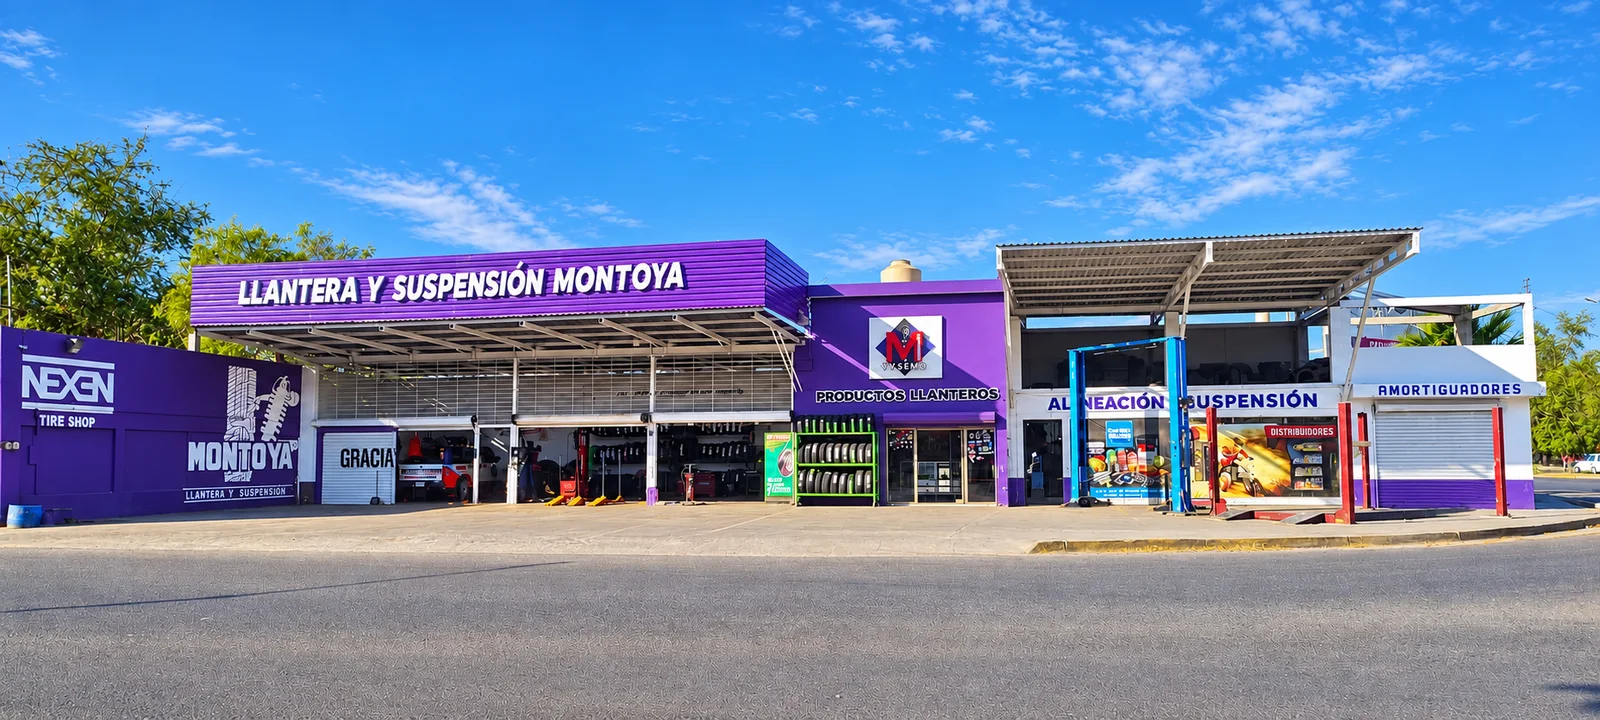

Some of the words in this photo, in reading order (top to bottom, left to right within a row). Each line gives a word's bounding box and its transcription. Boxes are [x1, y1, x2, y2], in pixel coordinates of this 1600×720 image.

[238, 276, 359, 306] LLANTERA
[368, 275, 386, 303] Y
[392, 260, 546, 303] SUSPENSIÓN
[552, 261, 686, 294] MONTOYA
[21, 365, 114, 403] NEXEN
[1378, 383, 1522, 396] AMORTIGUADORES
[815, 389, 906, 403] PRODUCTOS
[909, 387, 1001, 402] LLANTEROS
[1048, 392, 1165, 411] ALNEACIÓN
[39, 414, 65, 427] TIRE
[67, 415, 96, 429] SHOP
[1270, 427, 1334, 436] DISTRIBUIDORES
[187, 441, 294, 472] MONTOYA
[185, 490, 226, 500] LLANTERA
[228, 489, 234, 498] Y
